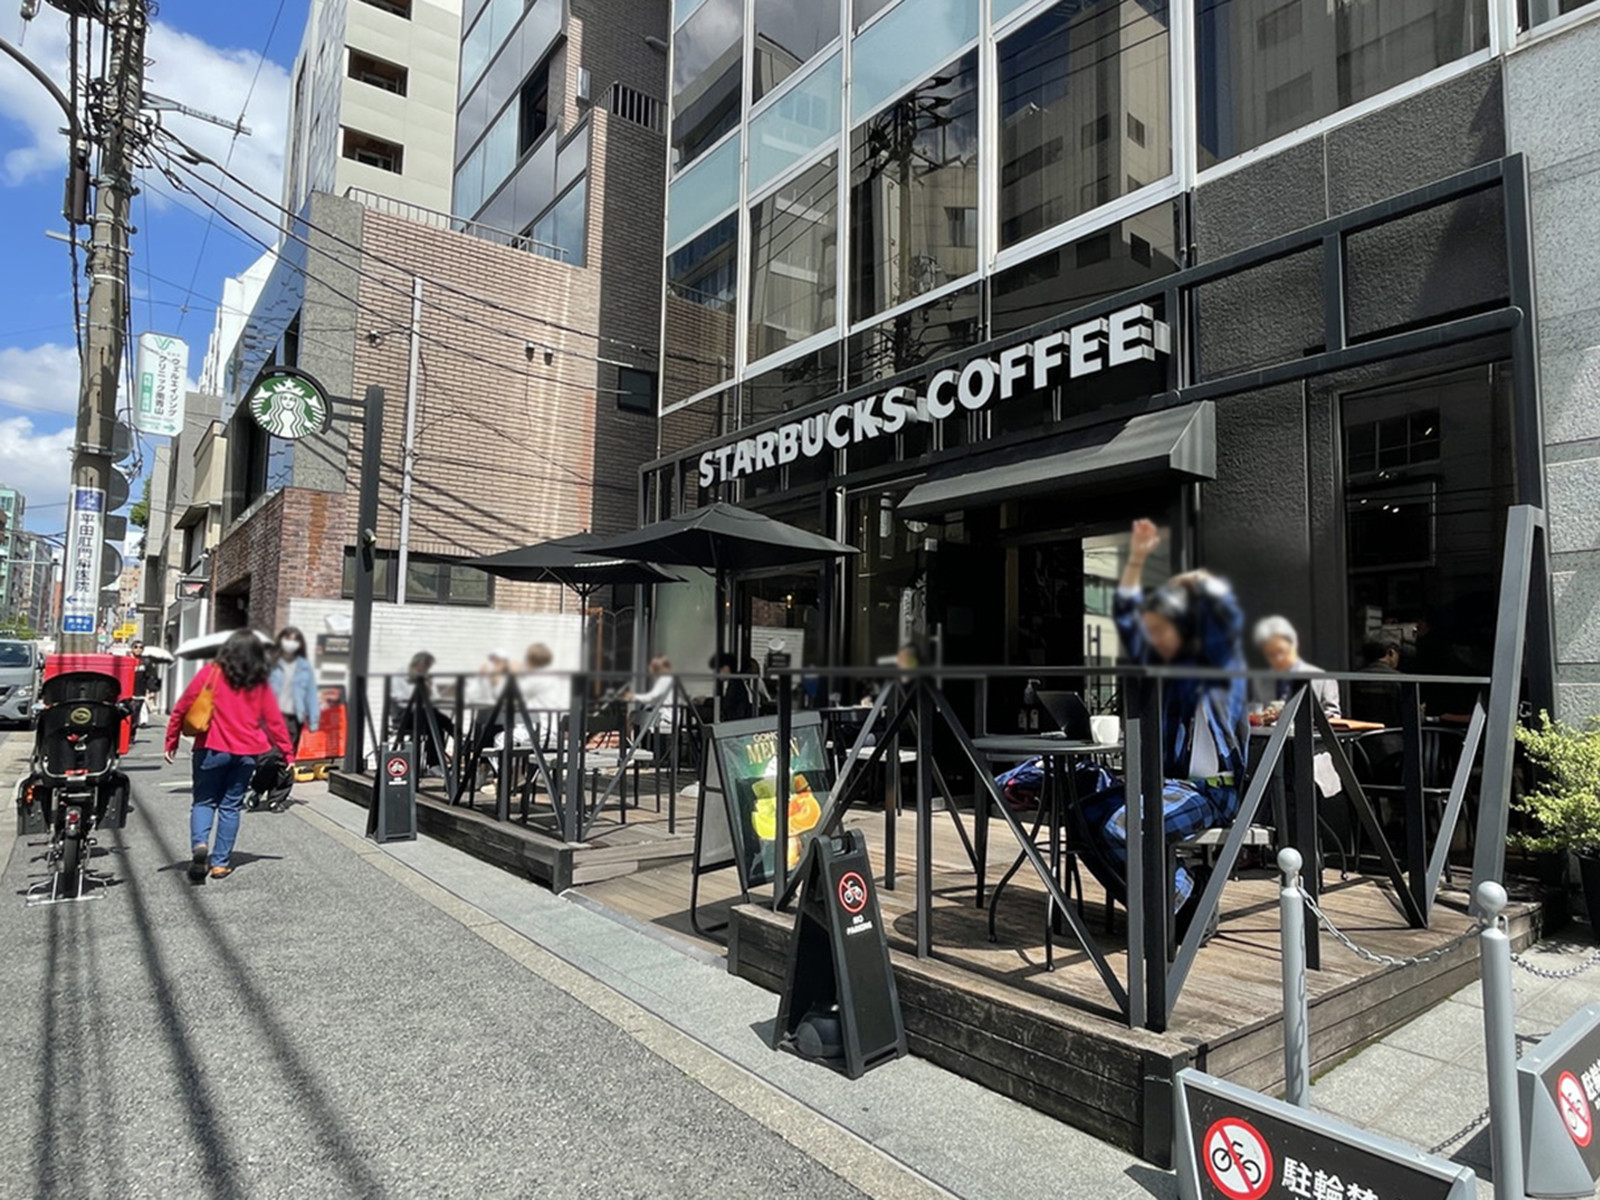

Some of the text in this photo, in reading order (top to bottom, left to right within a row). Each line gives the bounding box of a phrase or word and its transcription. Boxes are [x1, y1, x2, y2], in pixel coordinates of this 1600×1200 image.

[700, 303, 1155, 488] STARBUCKS COFFEE
[746, 737, 800, 765] MELN
